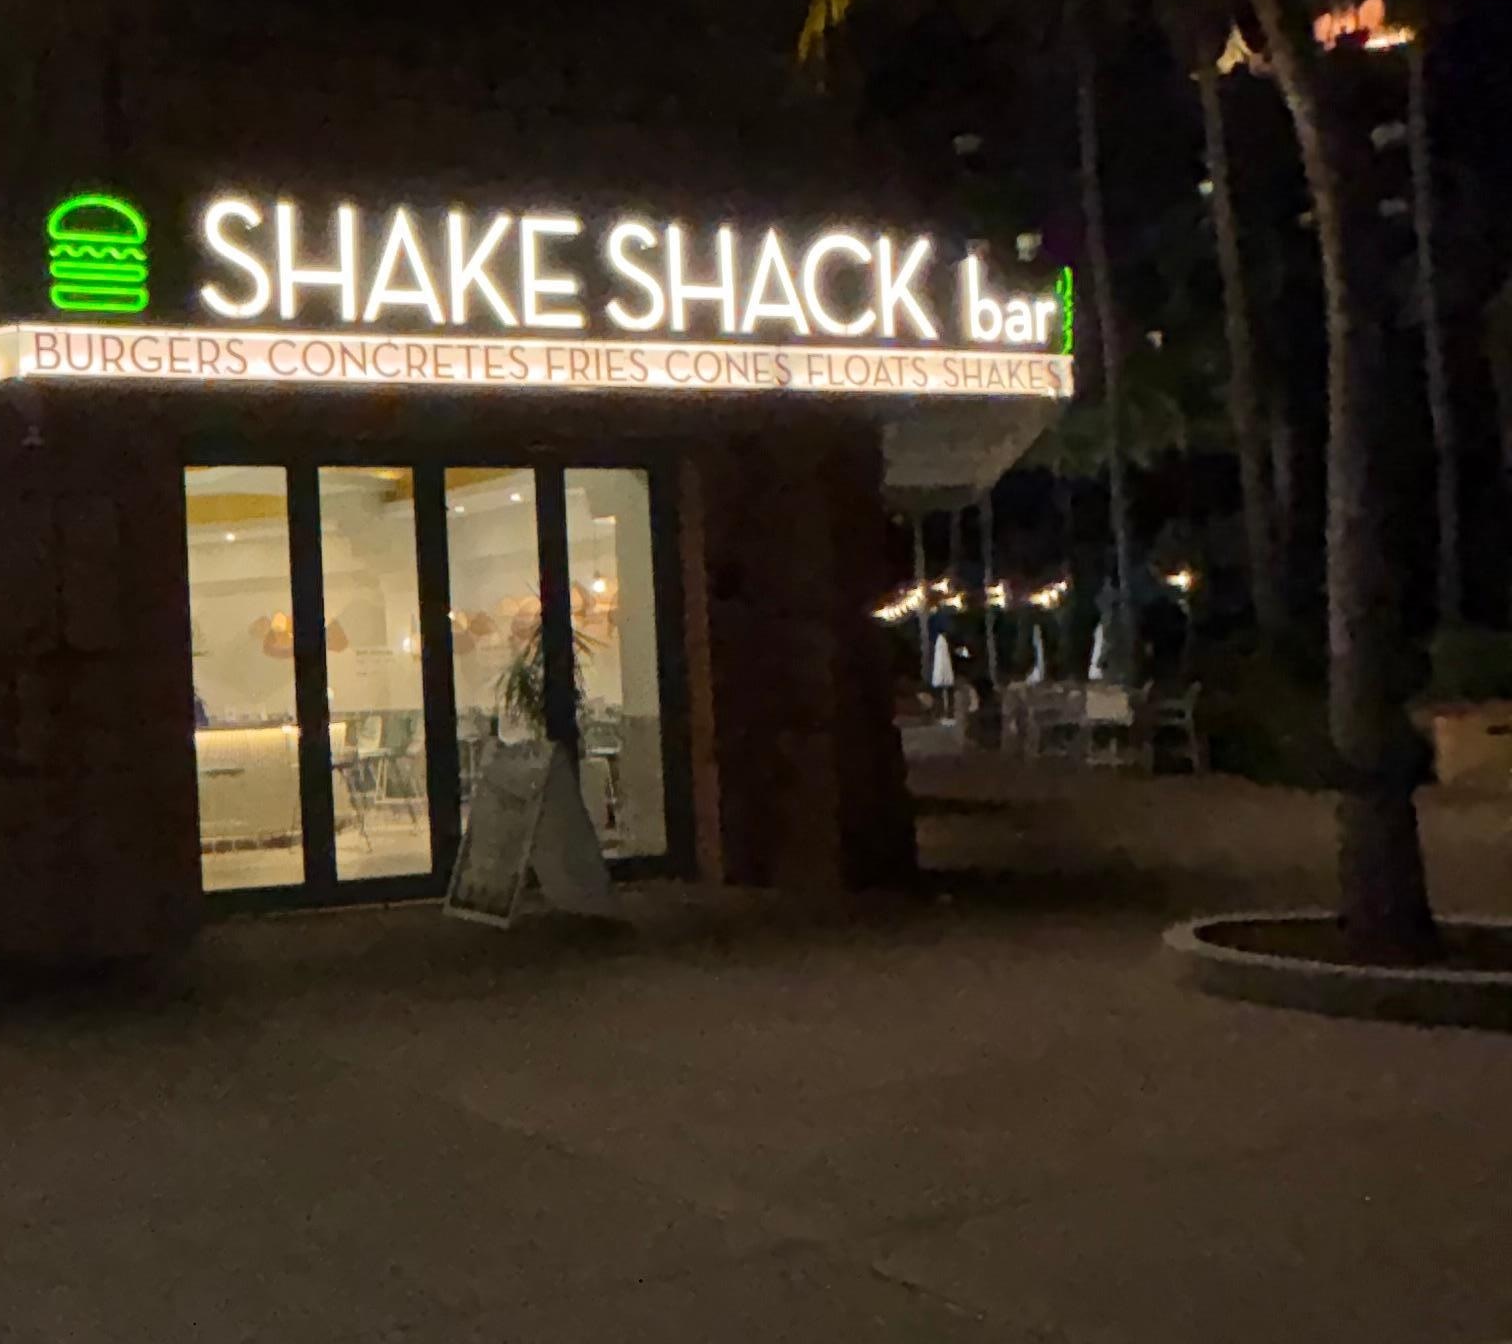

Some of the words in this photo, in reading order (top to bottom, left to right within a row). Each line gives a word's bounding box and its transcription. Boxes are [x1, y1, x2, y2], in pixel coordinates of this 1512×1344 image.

[200, 198, 585, 327] SHAKE
[606, 221, 939, 338] SHACK
[967, 253, 1056, 342] bar
[35, 332, 248, 374] BURGERS
[267, 339, 529, 382] CONCRETES
[546, 347, 649, 383] FRIES
[665, 350, 792, 386] CONES
[808, 354, 929, 387] FLOATS
[944, 357, 1061, 390] SHAKES
